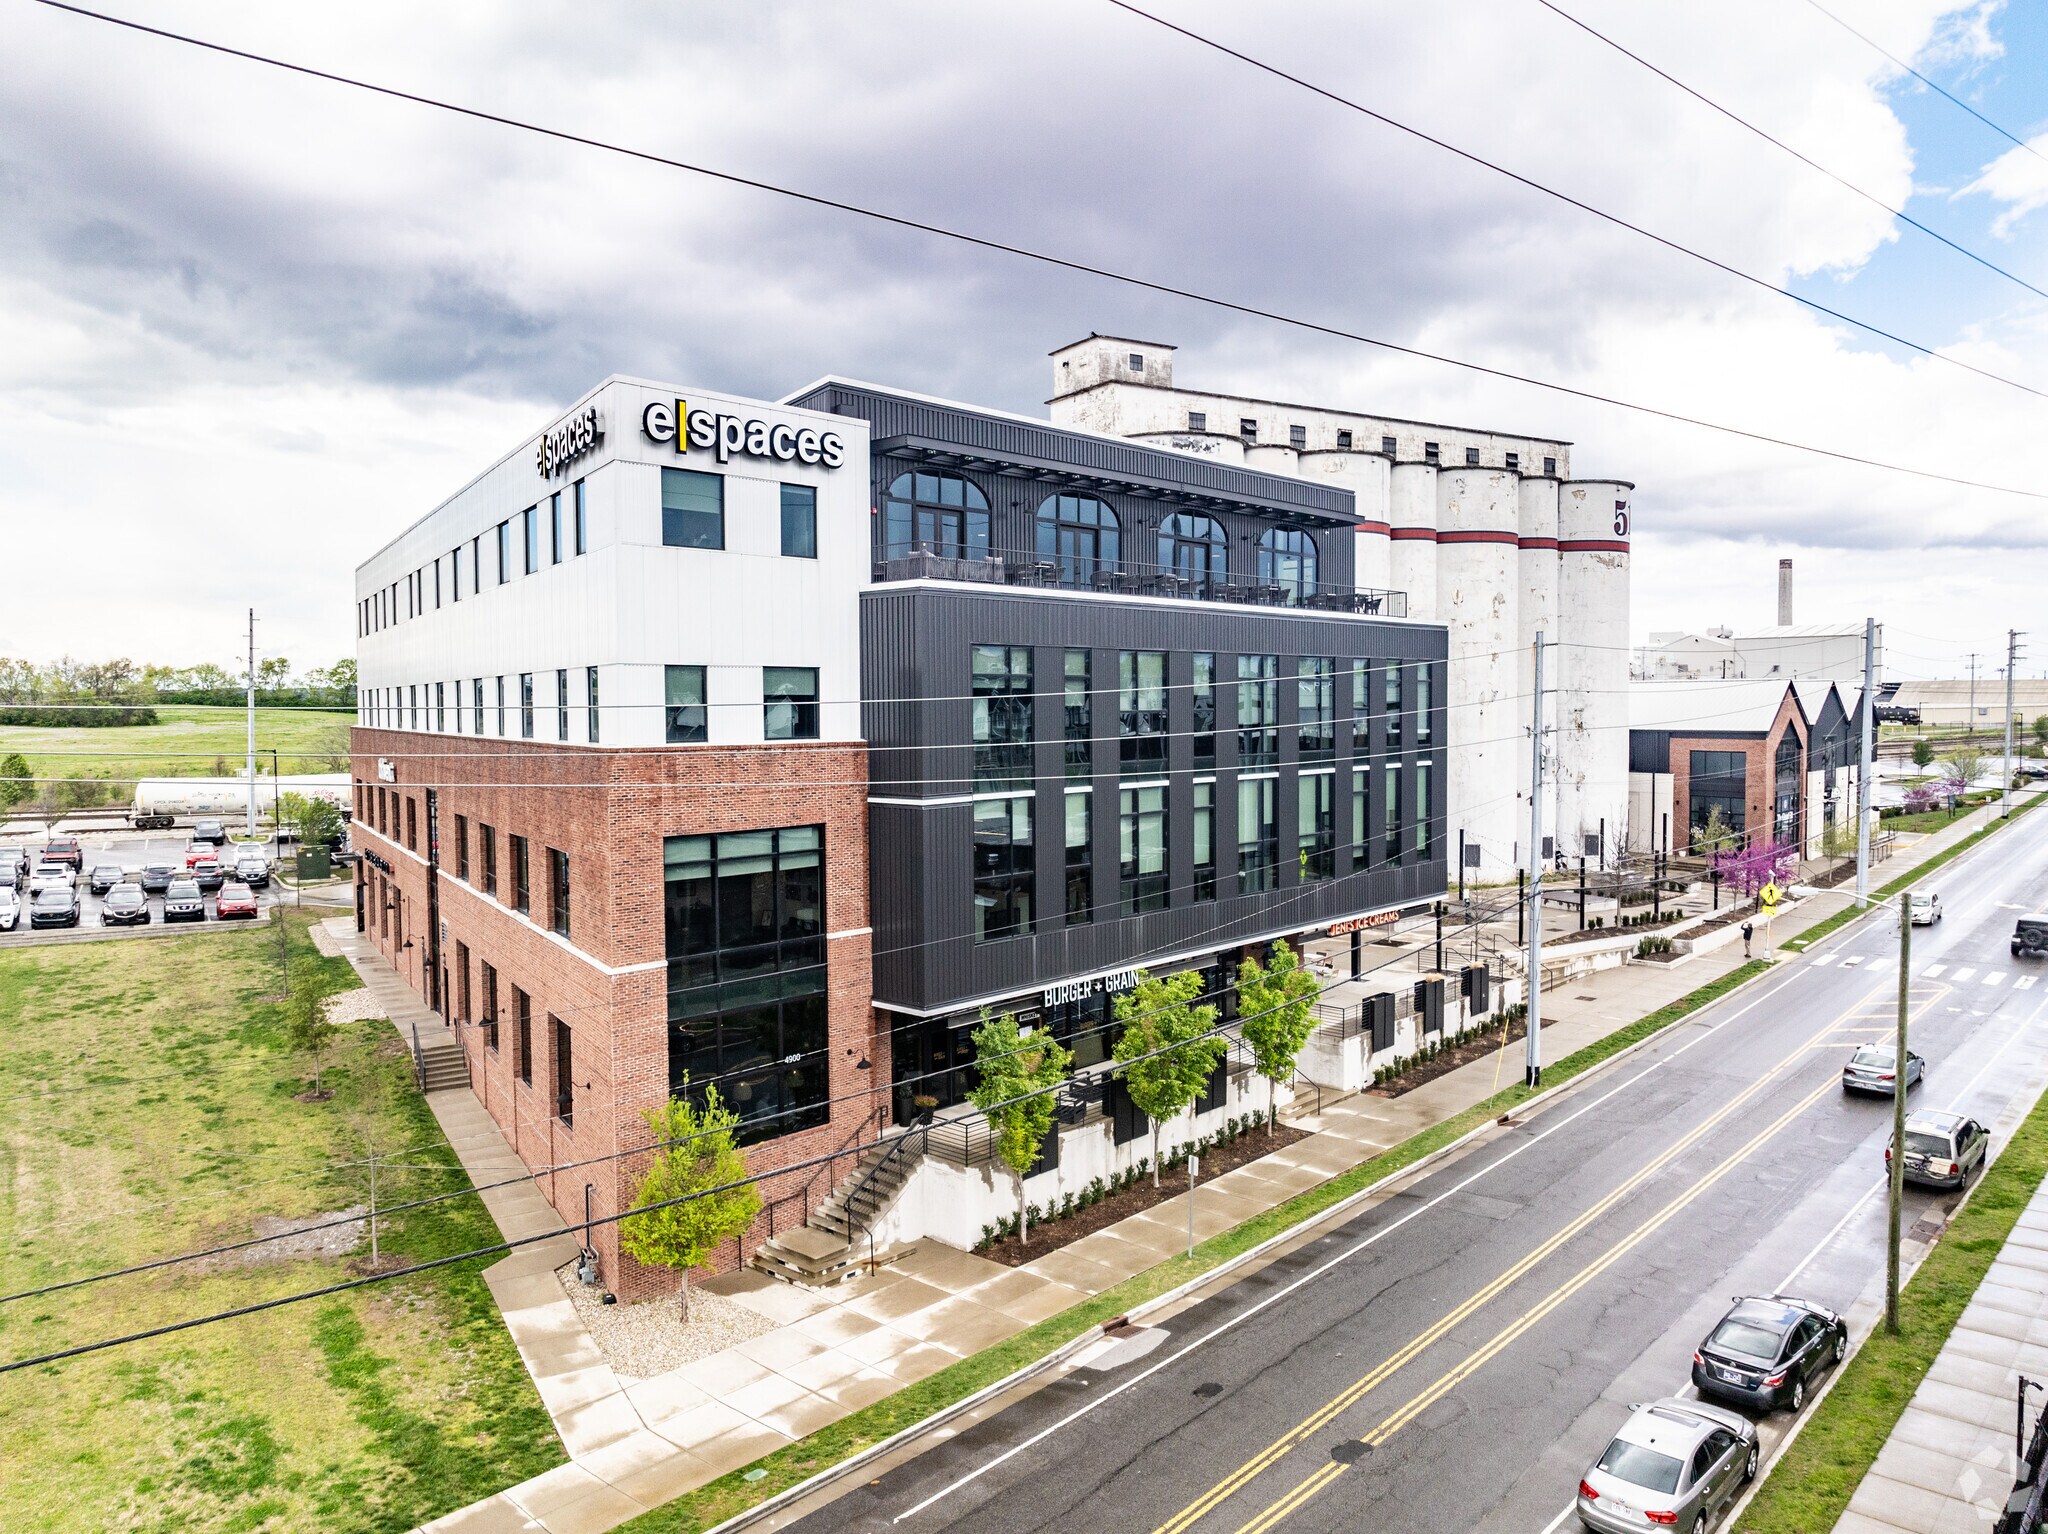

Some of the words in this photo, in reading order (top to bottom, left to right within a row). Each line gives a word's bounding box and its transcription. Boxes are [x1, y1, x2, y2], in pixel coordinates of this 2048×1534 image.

[1330, 921, 1354, 936] JENI'S
[1355, 918, 1369, 930] ICE
[1369, 911, 1399, 926] CREAMS
[1044, 980, 1092, 1008] BURGER
[1105, 970, 1140, 993] GRAIN
[784, 1053, 801, 1064] 4900
